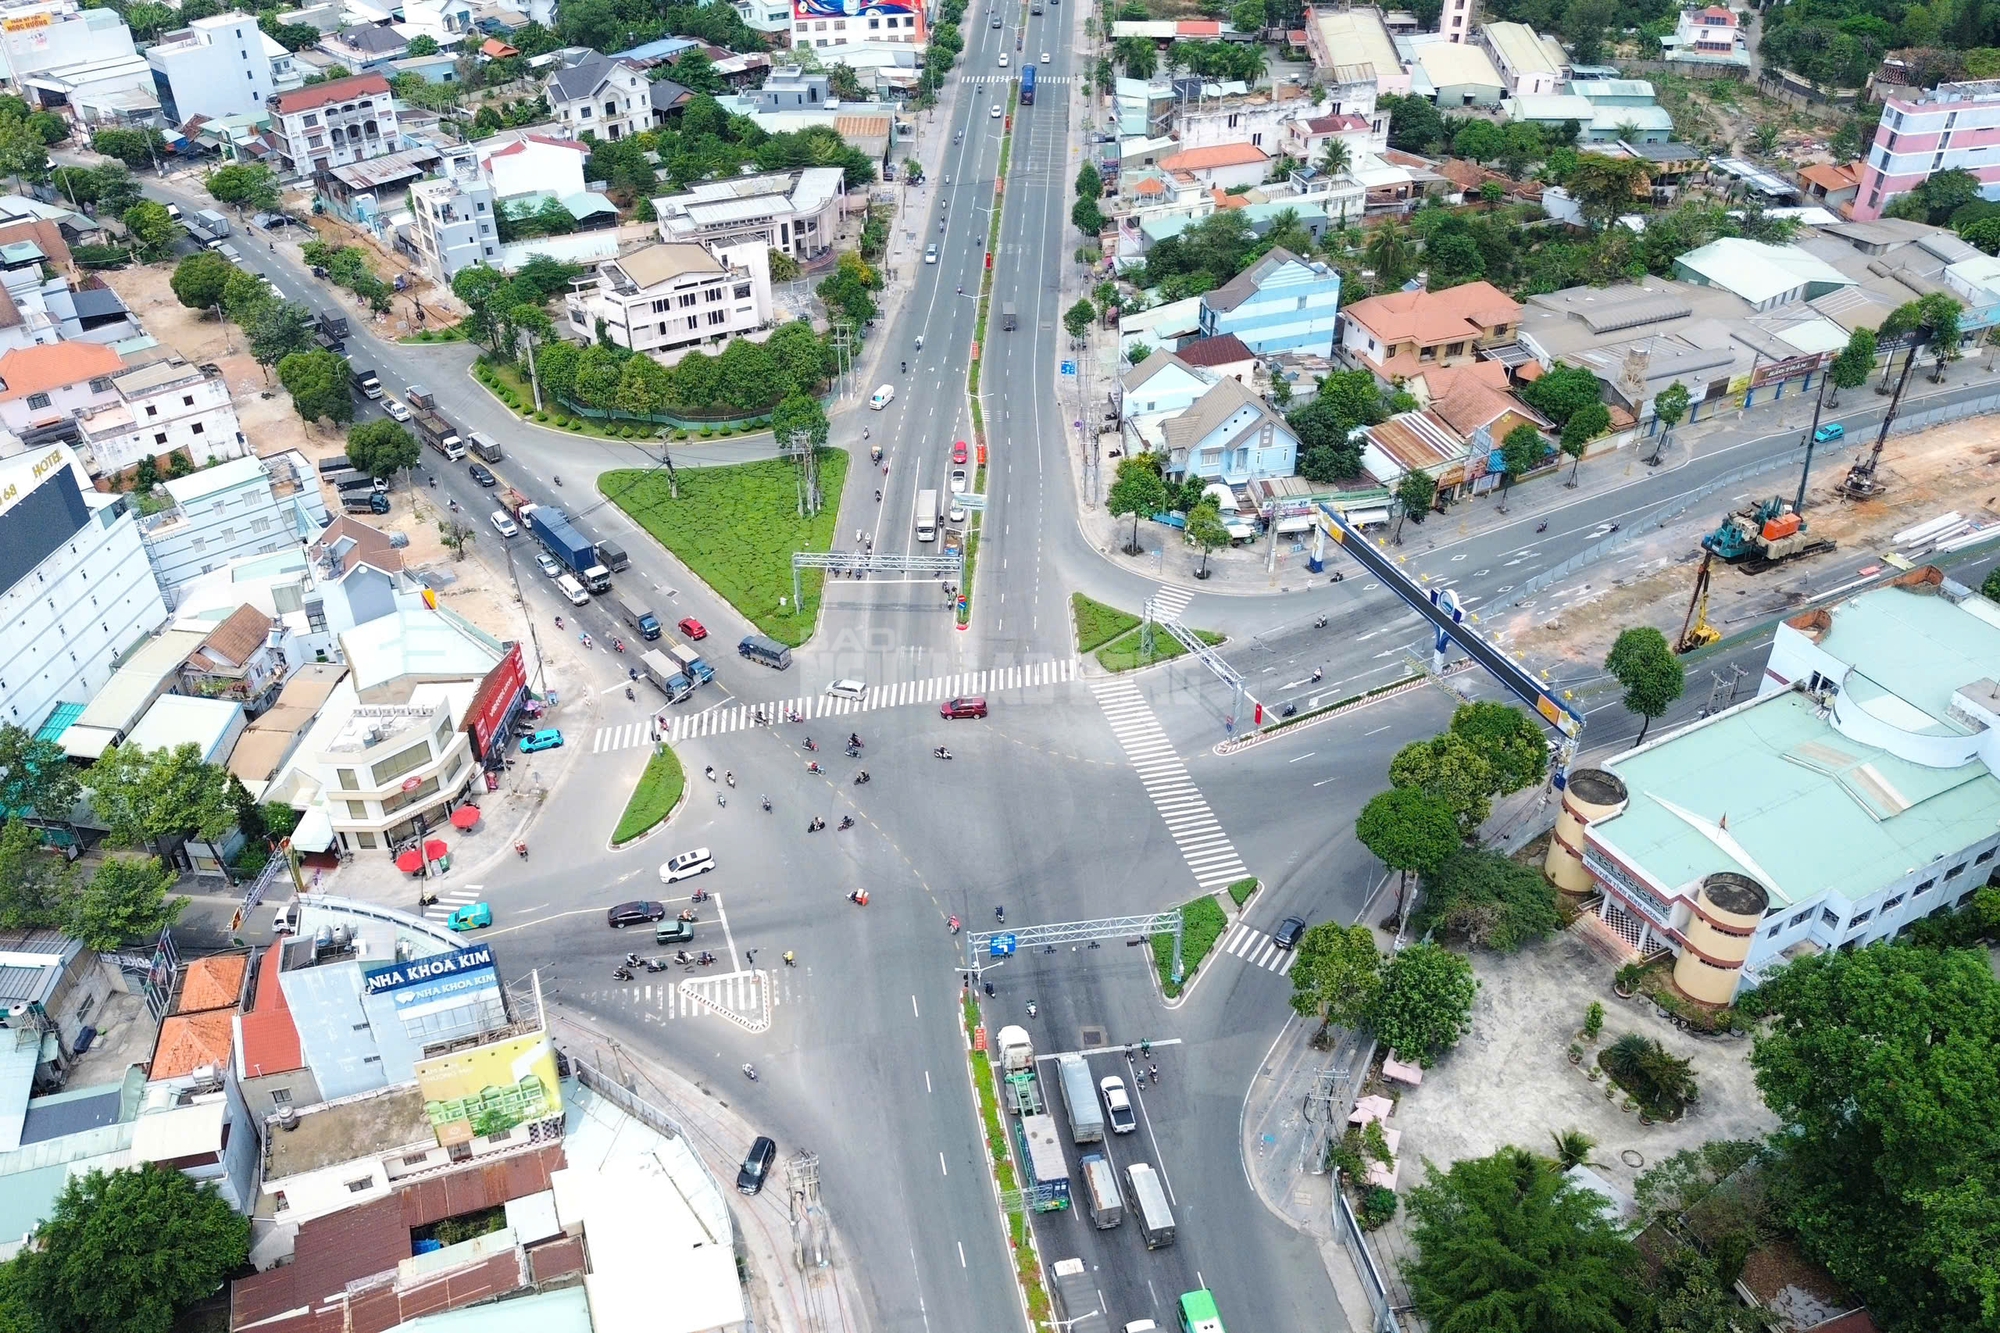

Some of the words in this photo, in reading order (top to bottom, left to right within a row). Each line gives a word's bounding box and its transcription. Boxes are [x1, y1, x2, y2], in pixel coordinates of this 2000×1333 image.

[32, 448, 63, 478] HOTEL
[397, 800, 442, 823] HIGHLANDS
[368, 971, 404, 990] NHA
[407, 959, 456, 981] KHOA
[457, 950, 491, 968] KIM
[416, 987, 441, 999] NHA
[442, 979, 473, 993] KHOA
[474, 974, 497, 985] KIM
